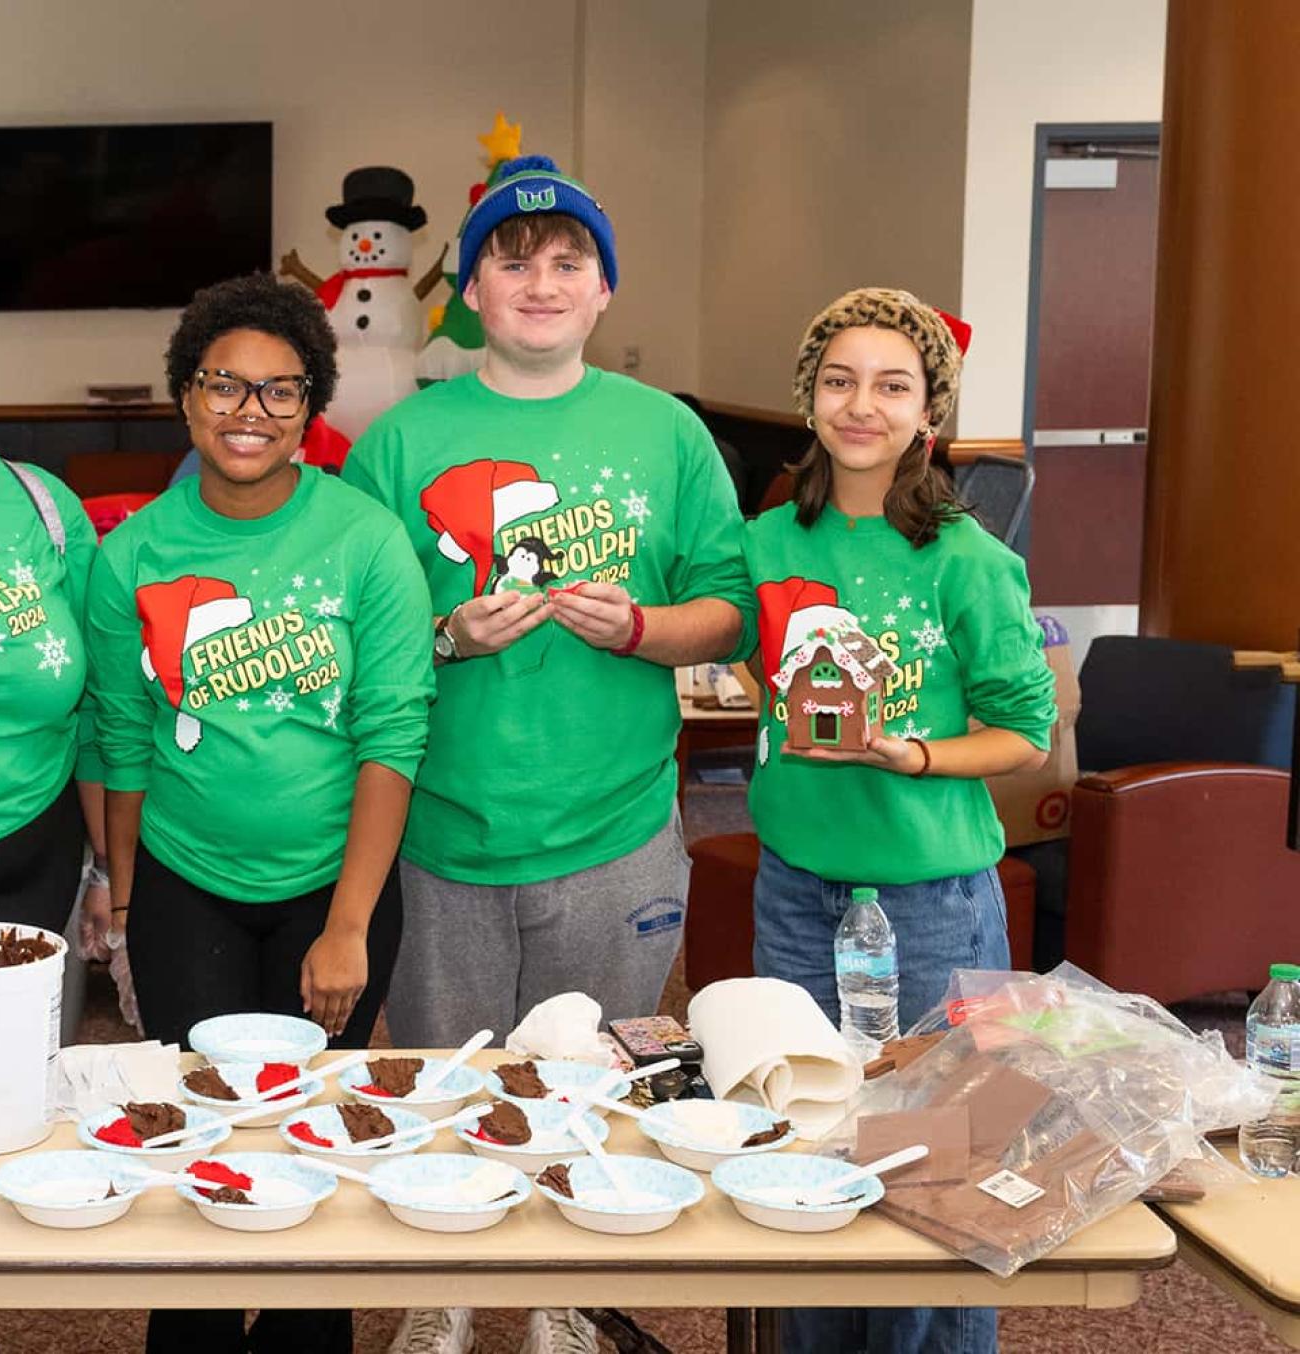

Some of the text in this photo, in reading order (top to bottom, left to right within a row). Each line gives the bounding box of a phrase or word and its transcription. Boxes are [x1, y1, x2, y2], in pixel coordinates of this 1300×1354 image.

[543, 526, 637, 578] DOLPH
[592, 562, 630, 586] 2024
[6, 604, 48, 636] 2024
[189, 608, 305, 677] FRIENDS
[187, 623, 336, 710] OF RUDOLPH
[295, 659, 342, 696] 2024
[882, 694, 919, 722] 024
